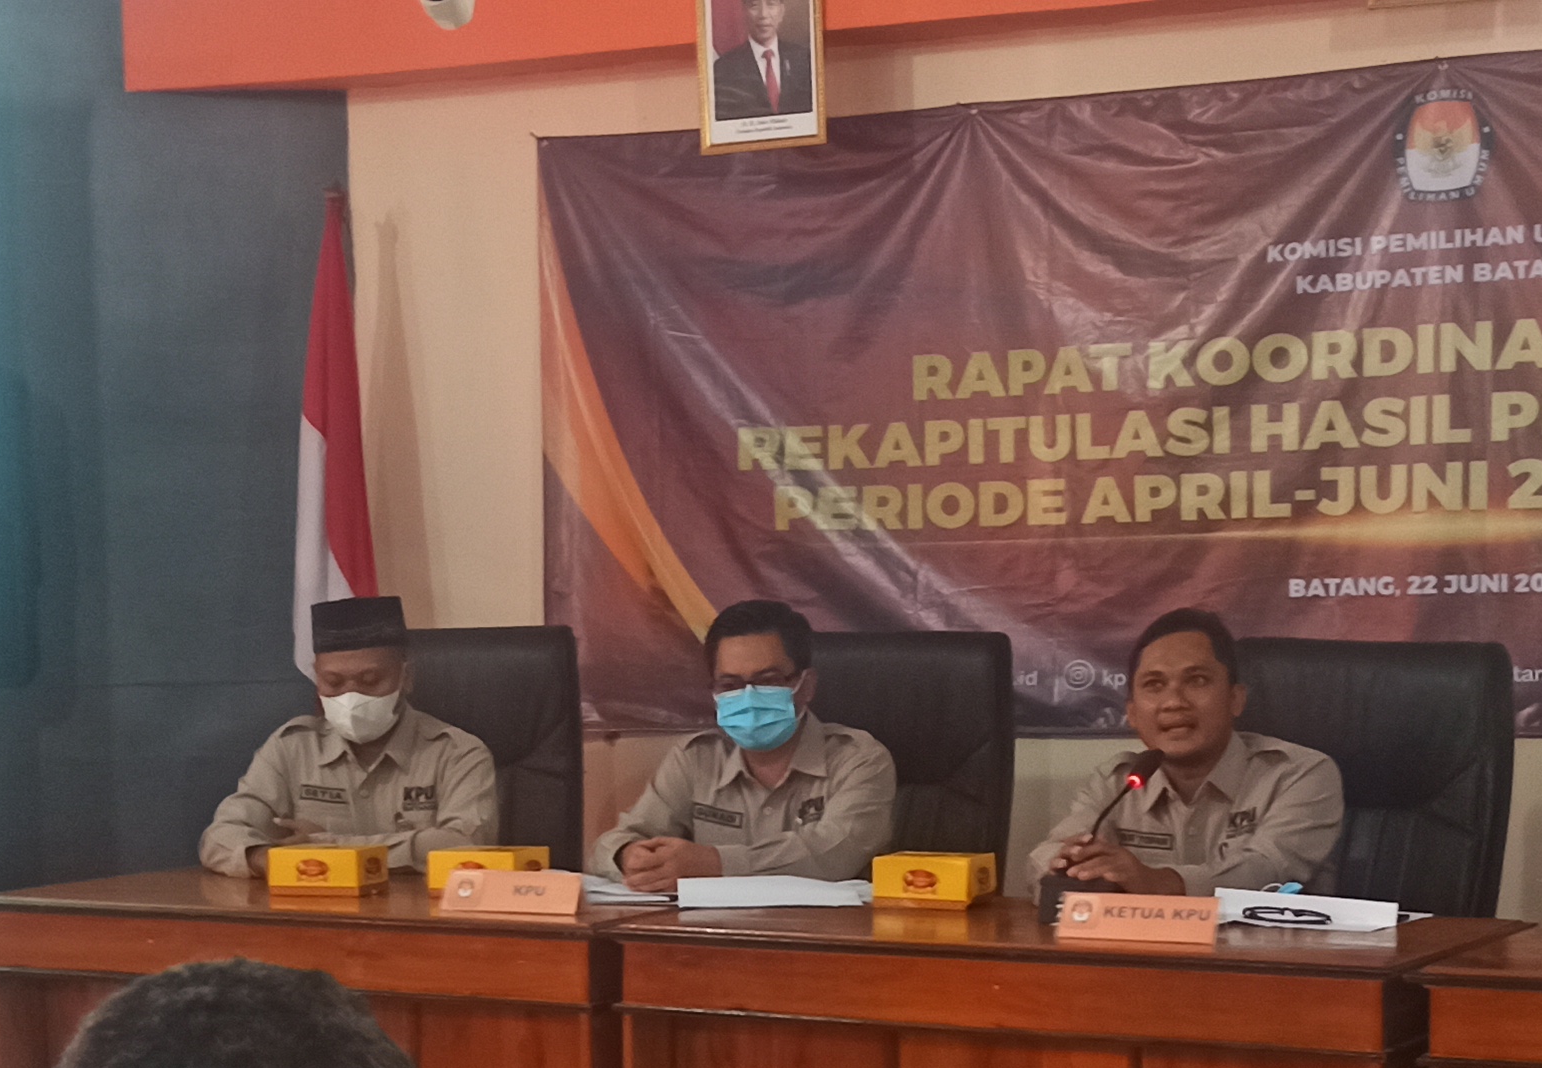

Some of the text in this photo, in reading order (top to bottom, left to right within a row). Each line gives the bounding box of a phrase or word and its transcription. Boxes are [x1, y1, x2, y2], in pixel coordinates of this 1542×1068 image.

[1414, 89, 1473, 104] KOMISI
[1464, 149, 1490, 197] UMUM
[1267, 237, 1362, 263] KOMISI
[1370, 225, 1525, 254] PEMILIHAN
[1295, 264, 1464, 294] KABUPATEN
[912, 343, 1133, 401] RAPAT
[736, 405, 1231, 473] REKAPITULASI
[1249, 393, 1472, 453] HASIL
[774, 478, 1067, 532] PERIODE
[1080, 460, 1489, 525] APRIL-JUNI
[1288, 576, 1402, 598] BATANG,
[1406, 575, 1439, 595] 22
[1442, 573, 1509, 595] JUNI
[403, 785, 436, 802] KPU
[513, 884, 546, 897] KPU
[1103, 905, 1212, 922] KETUA KPU
